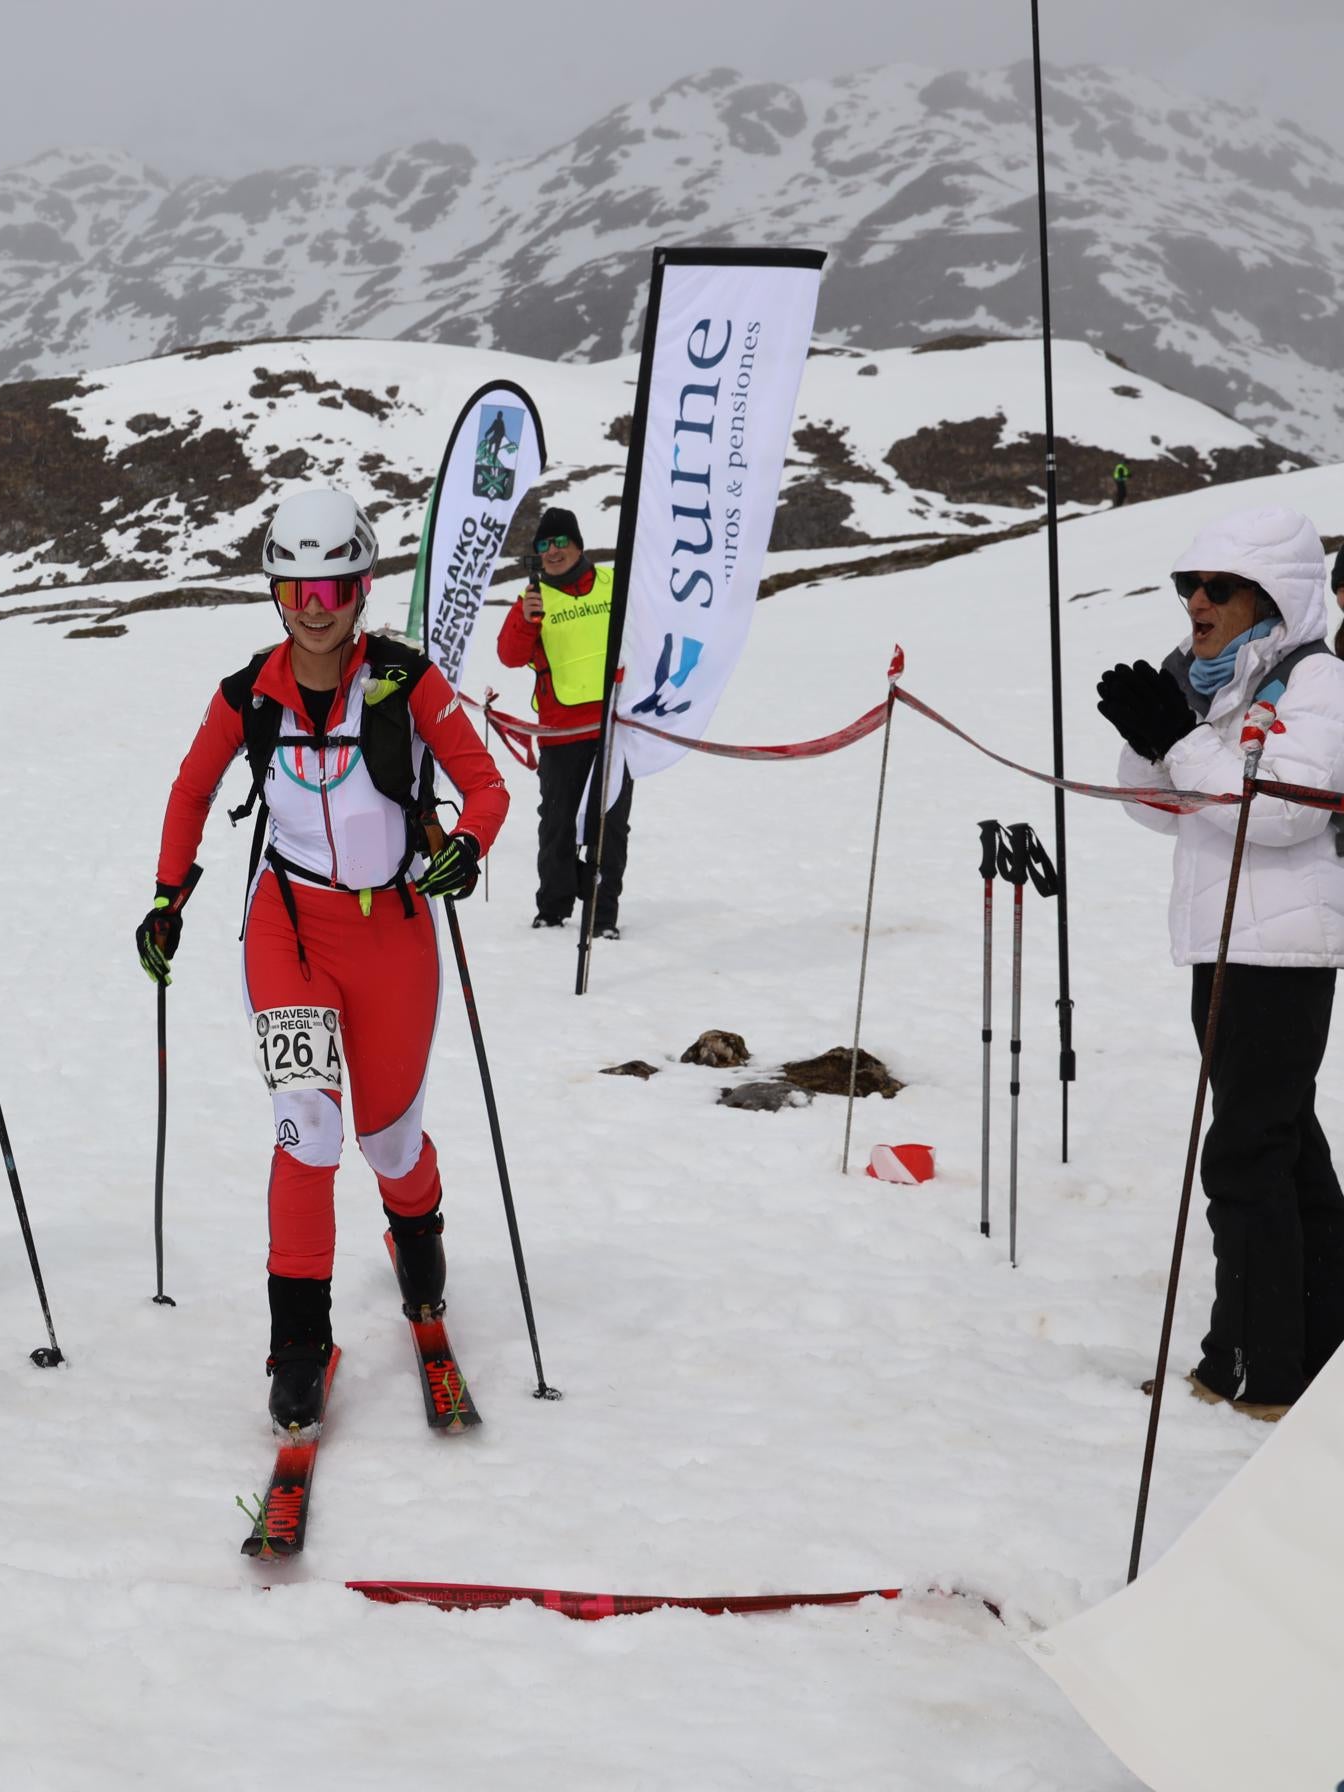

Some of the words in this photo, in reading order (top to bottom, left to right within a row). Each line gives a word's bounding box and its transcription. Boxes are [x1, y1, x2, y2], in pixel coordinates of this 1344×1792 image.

[727, 321, 761, 470] pensiones
[668, 317, 732, 609] surne
[726, 479, 744, 498] &
[299, 540, 320, 549] PETZL
[280, 1020, 313, 1031] REGIL
[259, 1031, 313, 1072] 126
[327, 1035, 342, 1069] A
[424, 1360, 468, 1413] TOMIC
[265, 1486, 305, 1541] TOMIC
